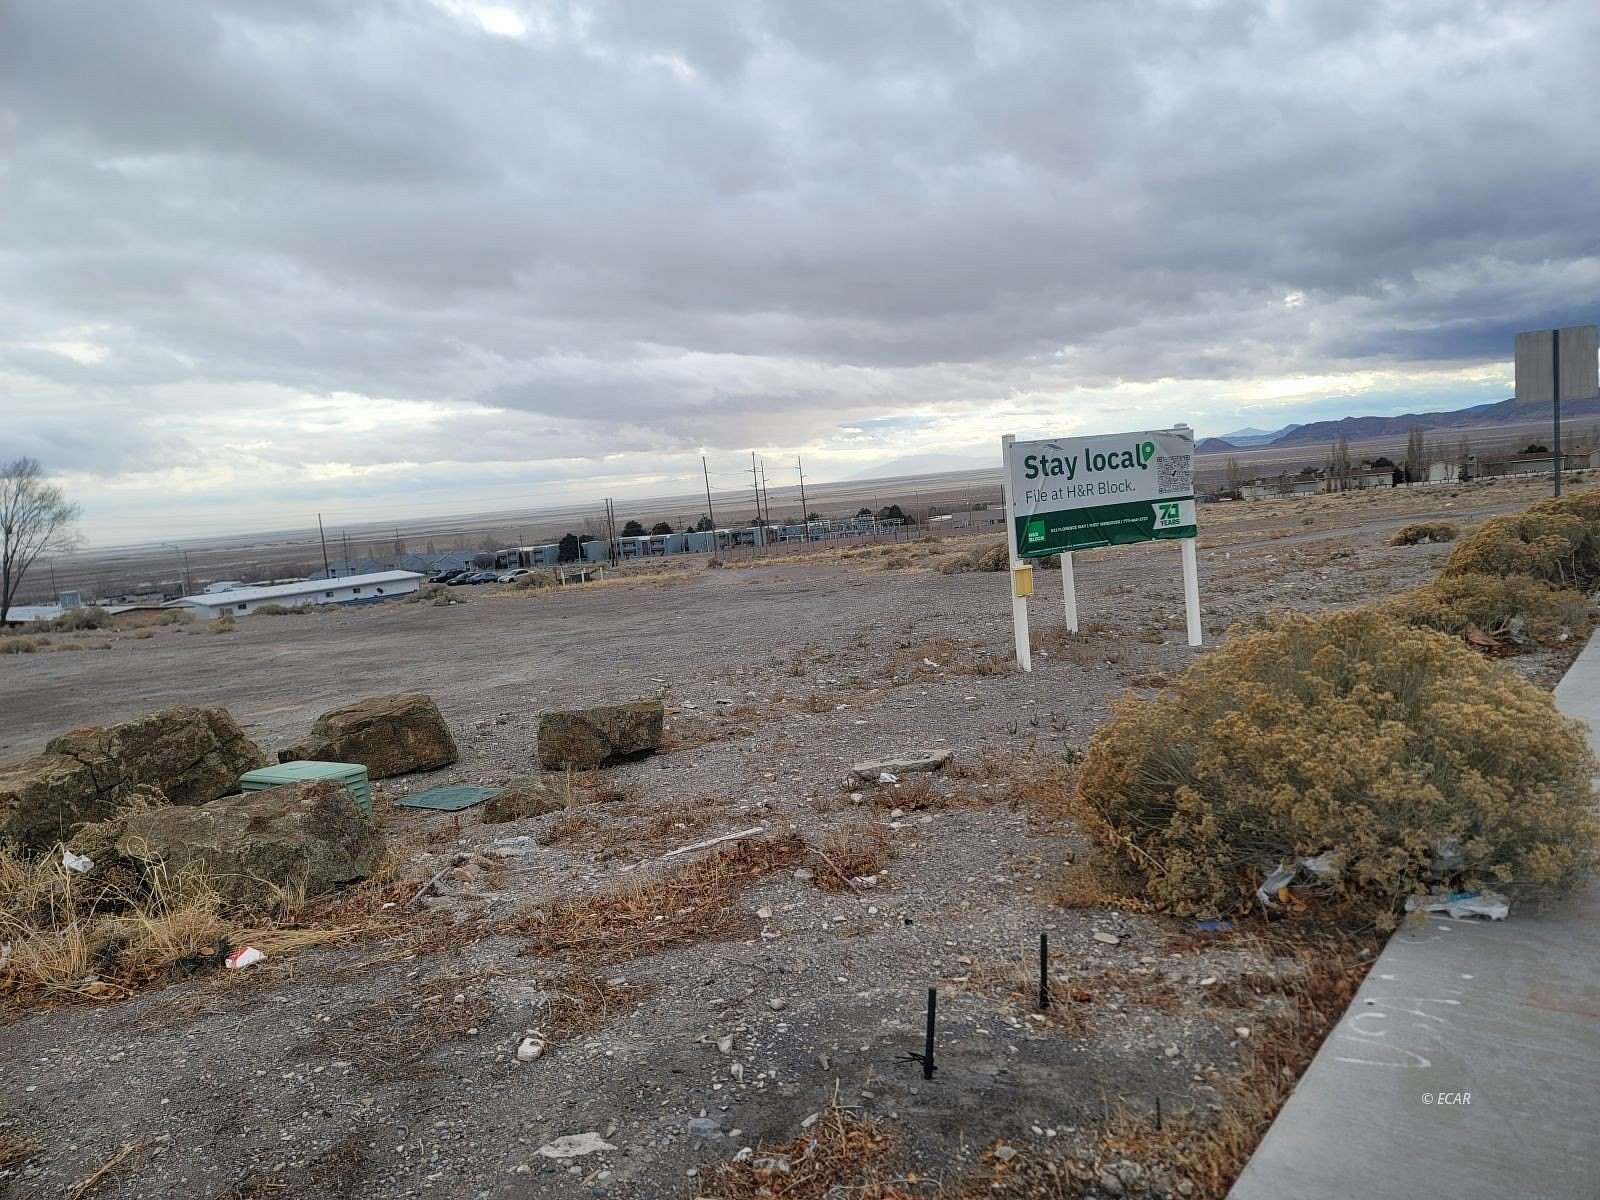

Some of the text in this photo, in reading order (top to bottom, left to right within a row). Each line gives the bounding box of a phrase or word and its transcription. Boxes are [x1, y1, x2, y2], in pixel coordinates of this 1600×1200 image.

[1024, 455, 1078, 480] Stay
[1026, 479, 1136, 504] File at H&R Block.
